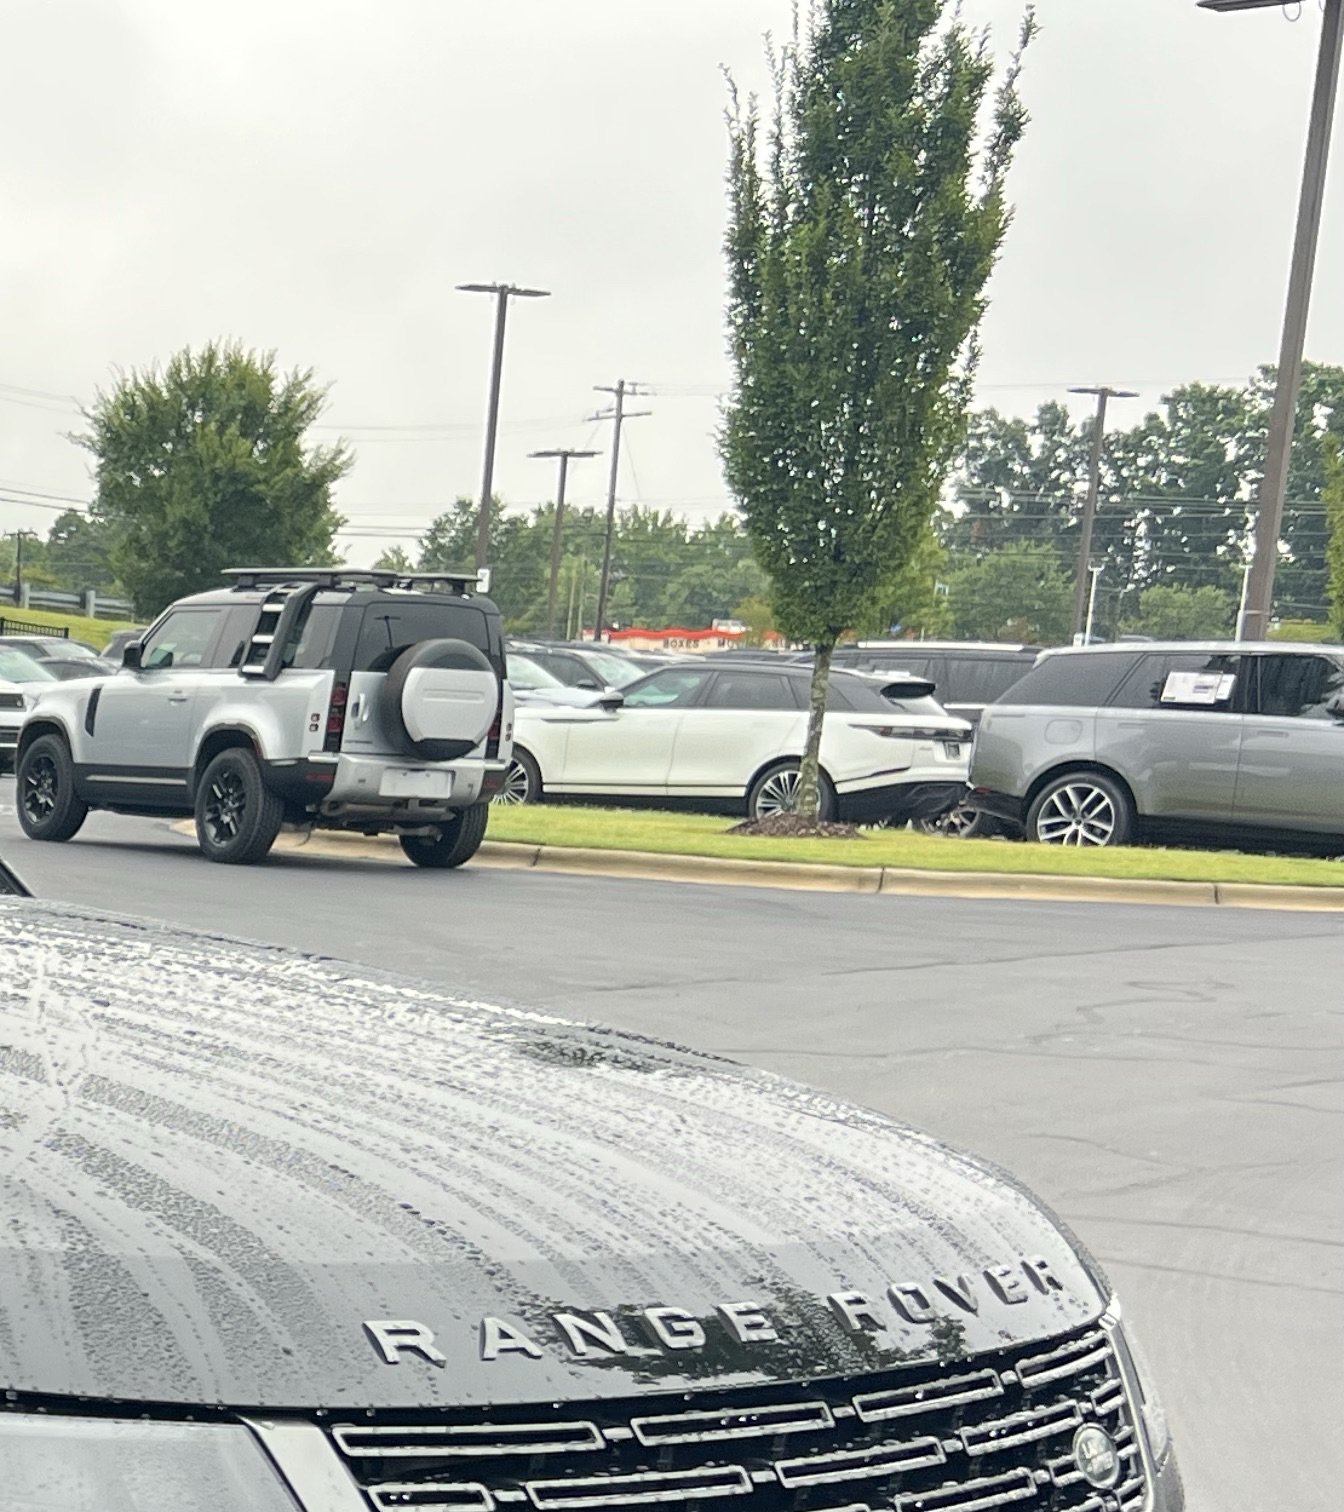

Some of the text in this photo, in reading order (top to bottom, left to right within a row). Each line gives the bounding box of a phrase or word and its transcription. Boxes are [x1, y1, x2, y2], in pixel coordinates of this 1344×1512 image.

[663, 638, 700, 649] BOXES
[362, 1254, 1064, 1368] RANGE ROVER
